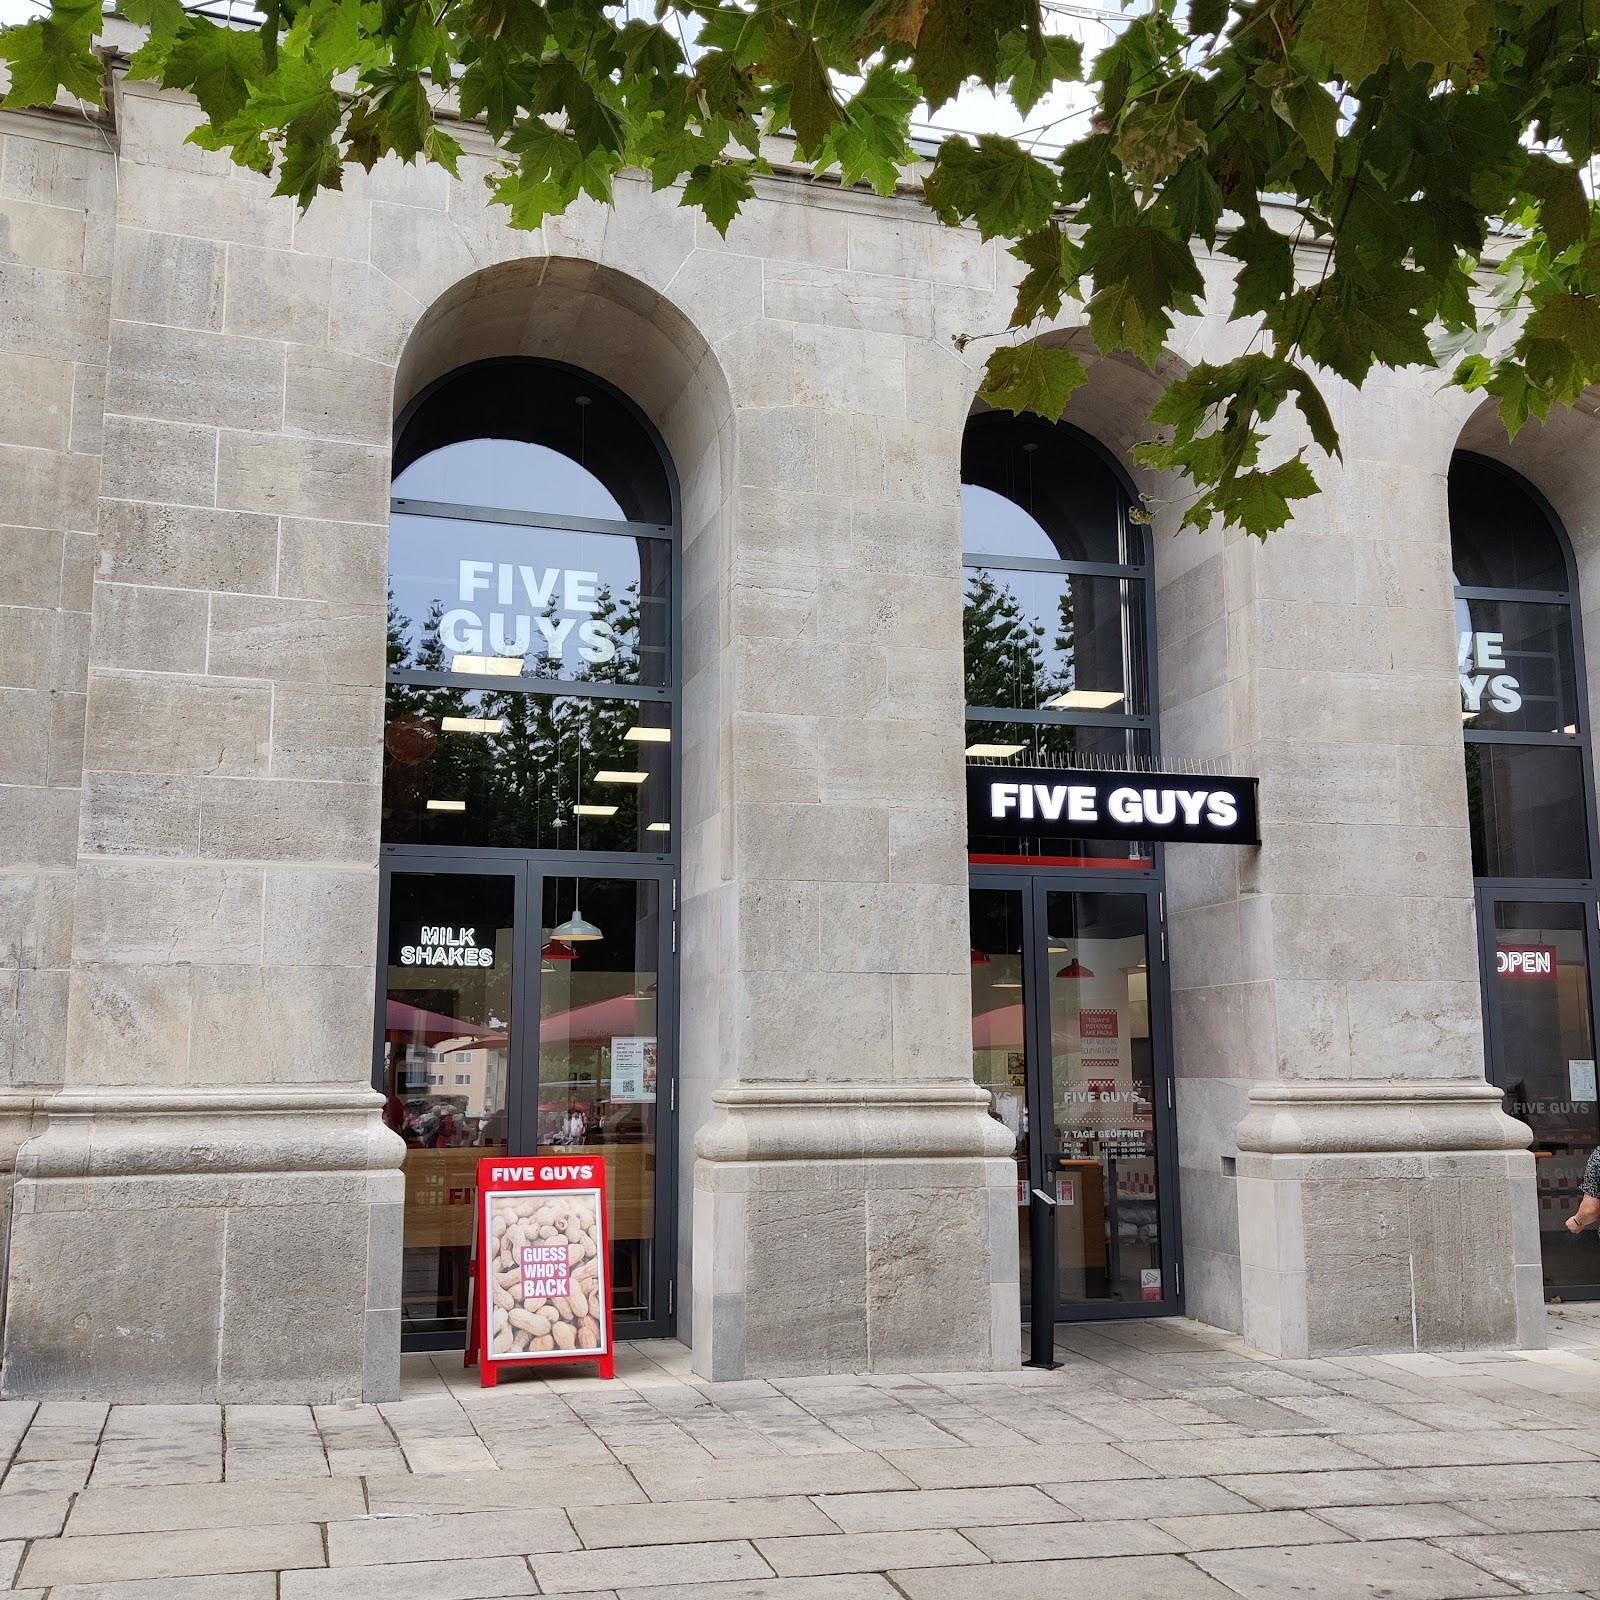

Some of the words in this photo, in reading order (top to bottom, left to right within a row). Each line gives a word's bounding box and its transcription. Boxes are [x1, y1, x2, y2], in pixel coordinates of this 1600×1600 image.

[459, 559, 599, 612] FIVE
[439, 608, 615, 663] GUYS
[1459, 674, 1522, 713] YS
[990, 783, 1098, 821] FIVE
[1108, 787, 1238, 827] GUYS
[420, 926, 475, 946] MILK
[400, 945, 493, 967] SHAKES
[1063, 1091, 1097, 1103] FIVE
[1100, 1091, 1139, 1103] GUYS
[1513, 1102, 1545, 1114] FIVE
[1549, 1102, 1589, 1114] GUYS
[1072, 1130, 1095, 1138] TAGE
[1098, 1128, 1145, 1138] GEÖFFNET
[491, 1167, 535, 1182] FIVE
[540, 1165, 593, 1181] GUYS
[523, 1246, 567, 1262] GUESS
[523, 1262, 567, 1278] WHO'S
[524, 1278, 568, 1297] BACK
